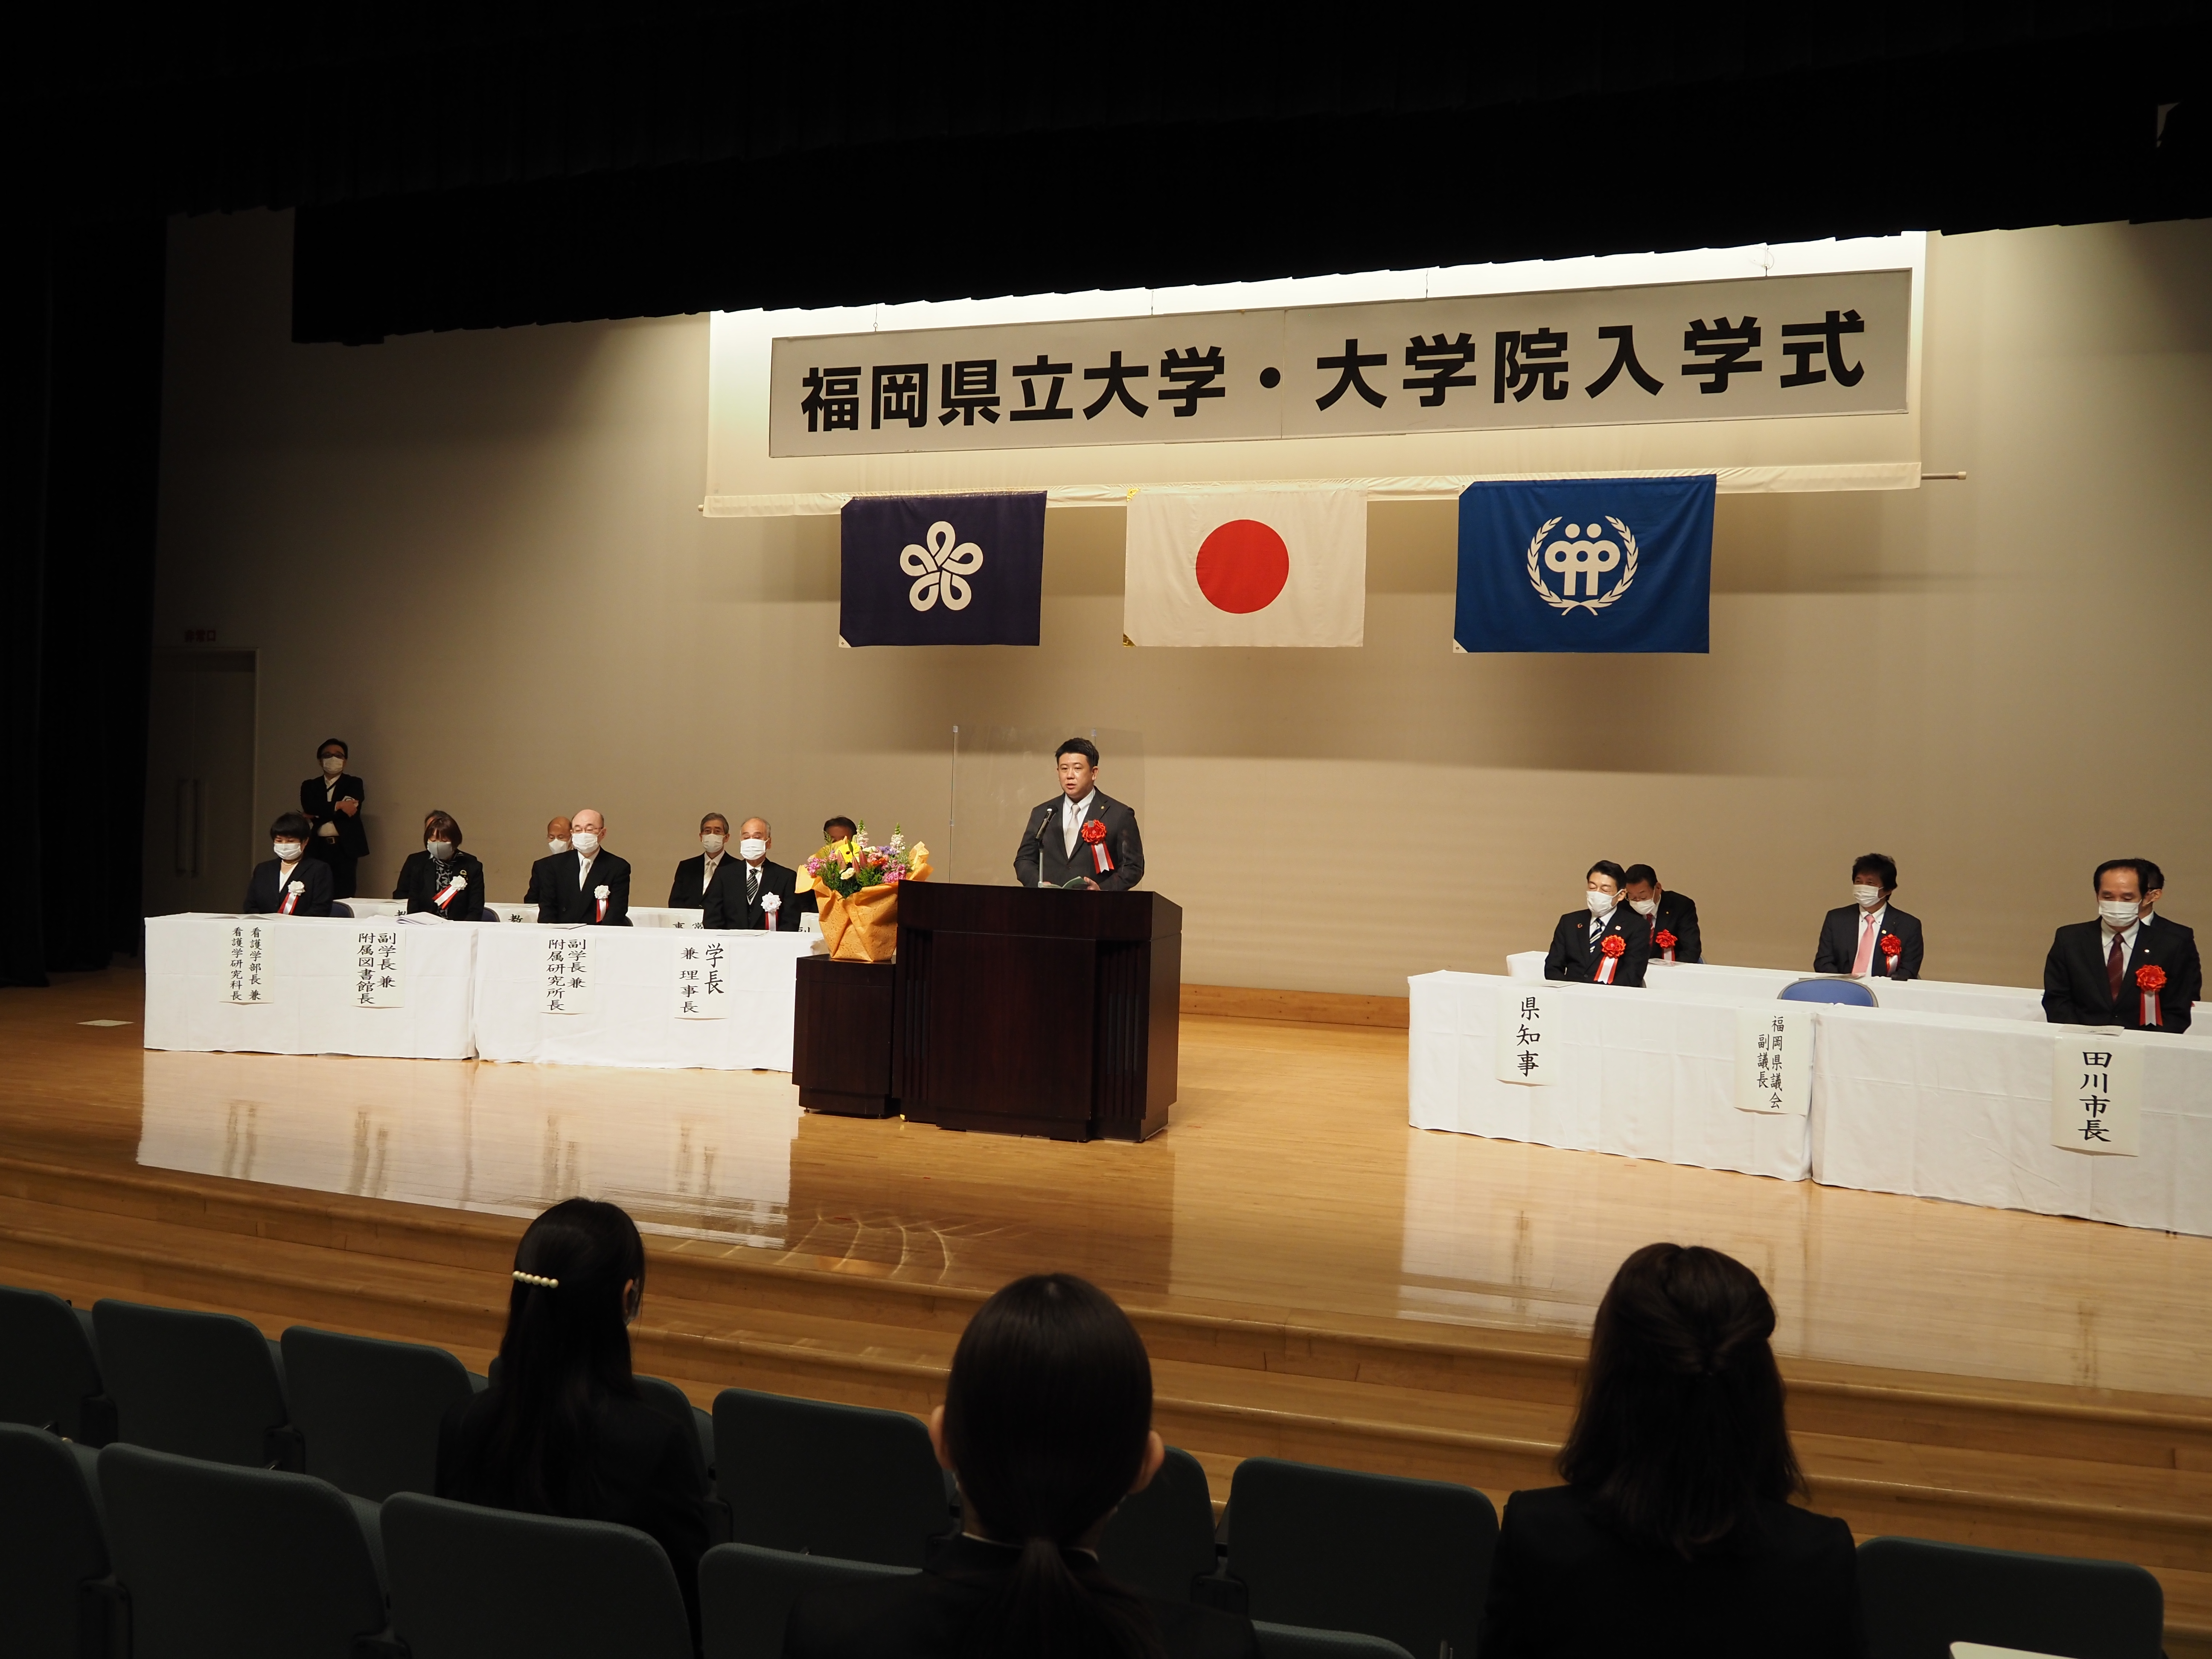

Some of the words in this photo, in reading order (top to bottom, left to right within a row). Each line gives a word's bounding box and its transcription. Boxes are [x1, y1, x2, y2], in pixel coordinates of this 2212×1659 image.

[801, 309, 1865, 432] 福岡県立大学・大学院入学式
[230, 927, 244, 1001] 看護学研究科長
[355, 932, 376, 1004] 附属図書館長
[546, 939, 566, 1011] 附属研究所長
[704, 942, 725, 995] 学長
[1516, 996, 1541, 1077] 県知事
[1756, 1033, 1770, 1089] 副議長
[1769, 1016, 1785, 1109] 福岡県議会
[2077, 1051, 2113, 1142] 田川市長
